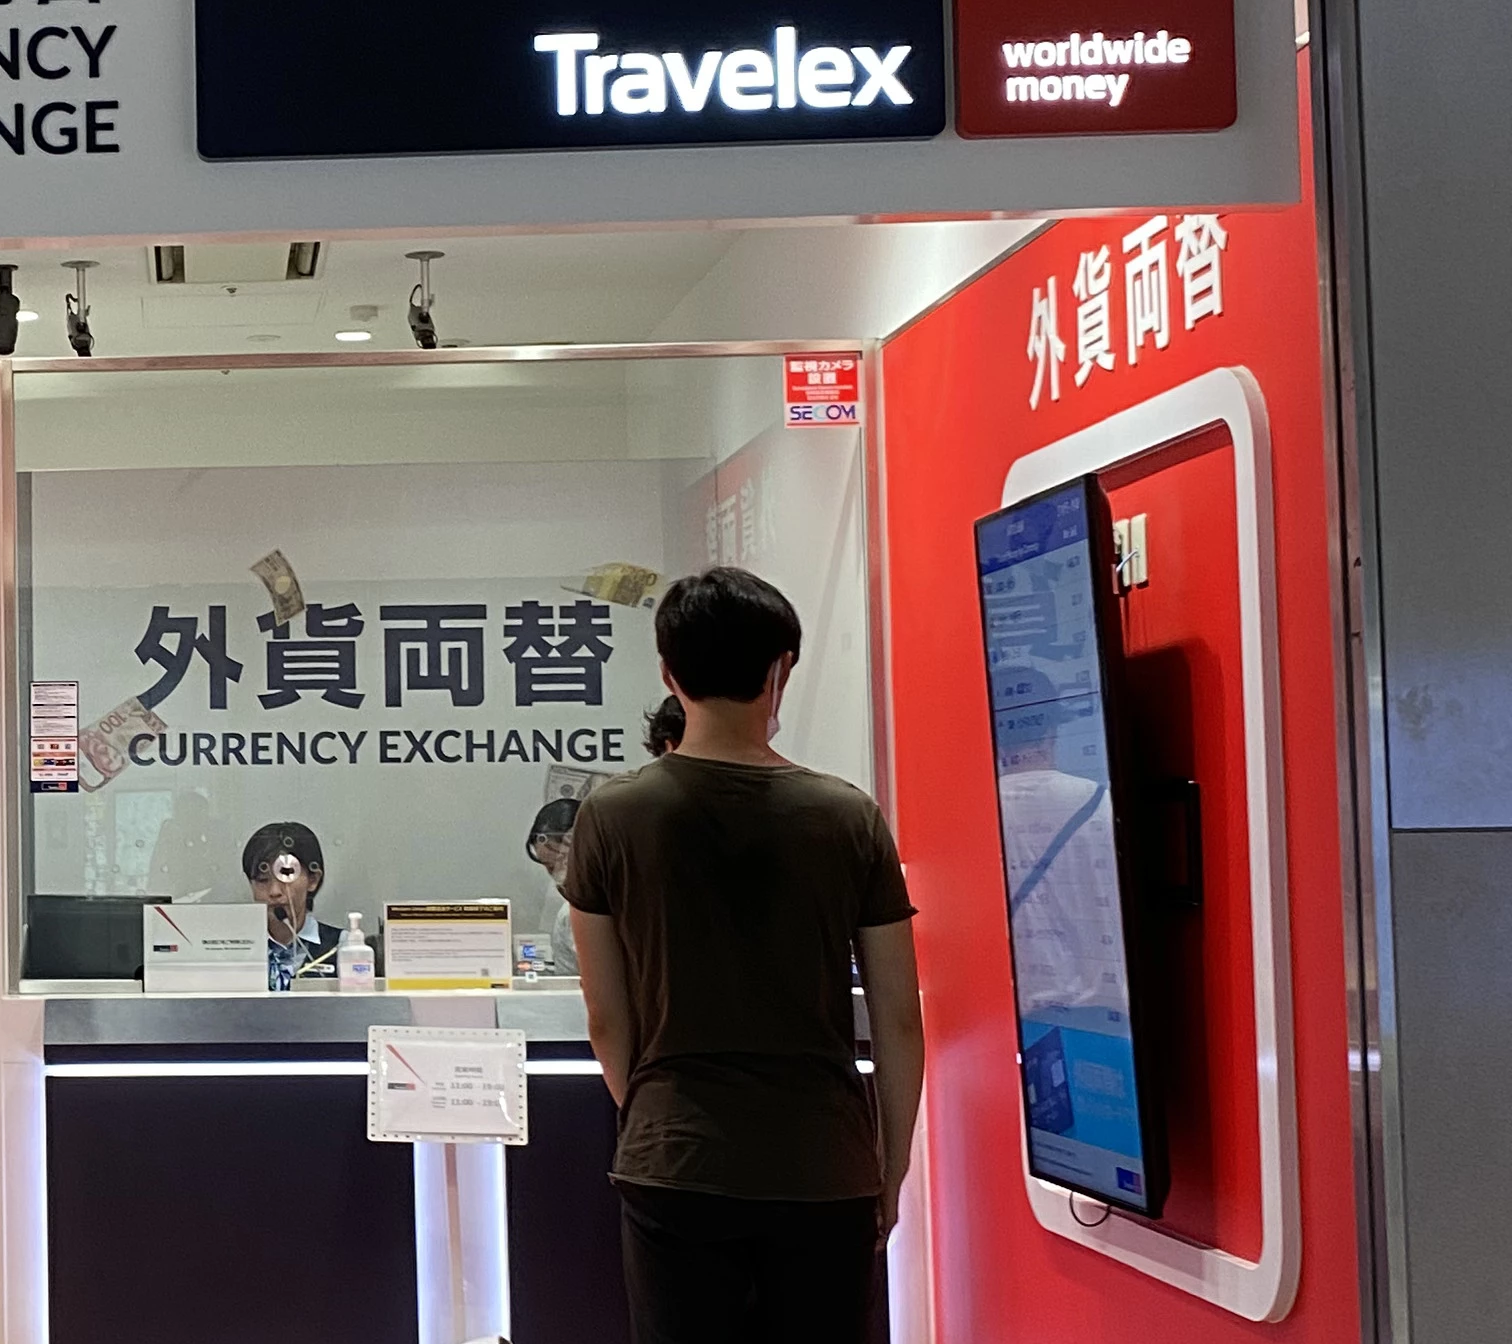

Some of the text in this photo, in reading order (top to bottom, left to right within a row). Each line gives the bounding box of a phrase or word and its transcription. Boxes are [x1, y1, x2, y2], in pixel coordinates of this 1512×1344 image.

[1001, 29, 1192, 69] worldwide
[533, 26, 915, 116] Travelex
[1004, 72, 1130, 107] money
[1027, 212, 1228, 410] 外貨両替
[790, 404, 856, 421] SECOM
[134, 599, 614, 711] 外貨両替
[128, 727, 626, 767] CURRENCY EXCHANGE
